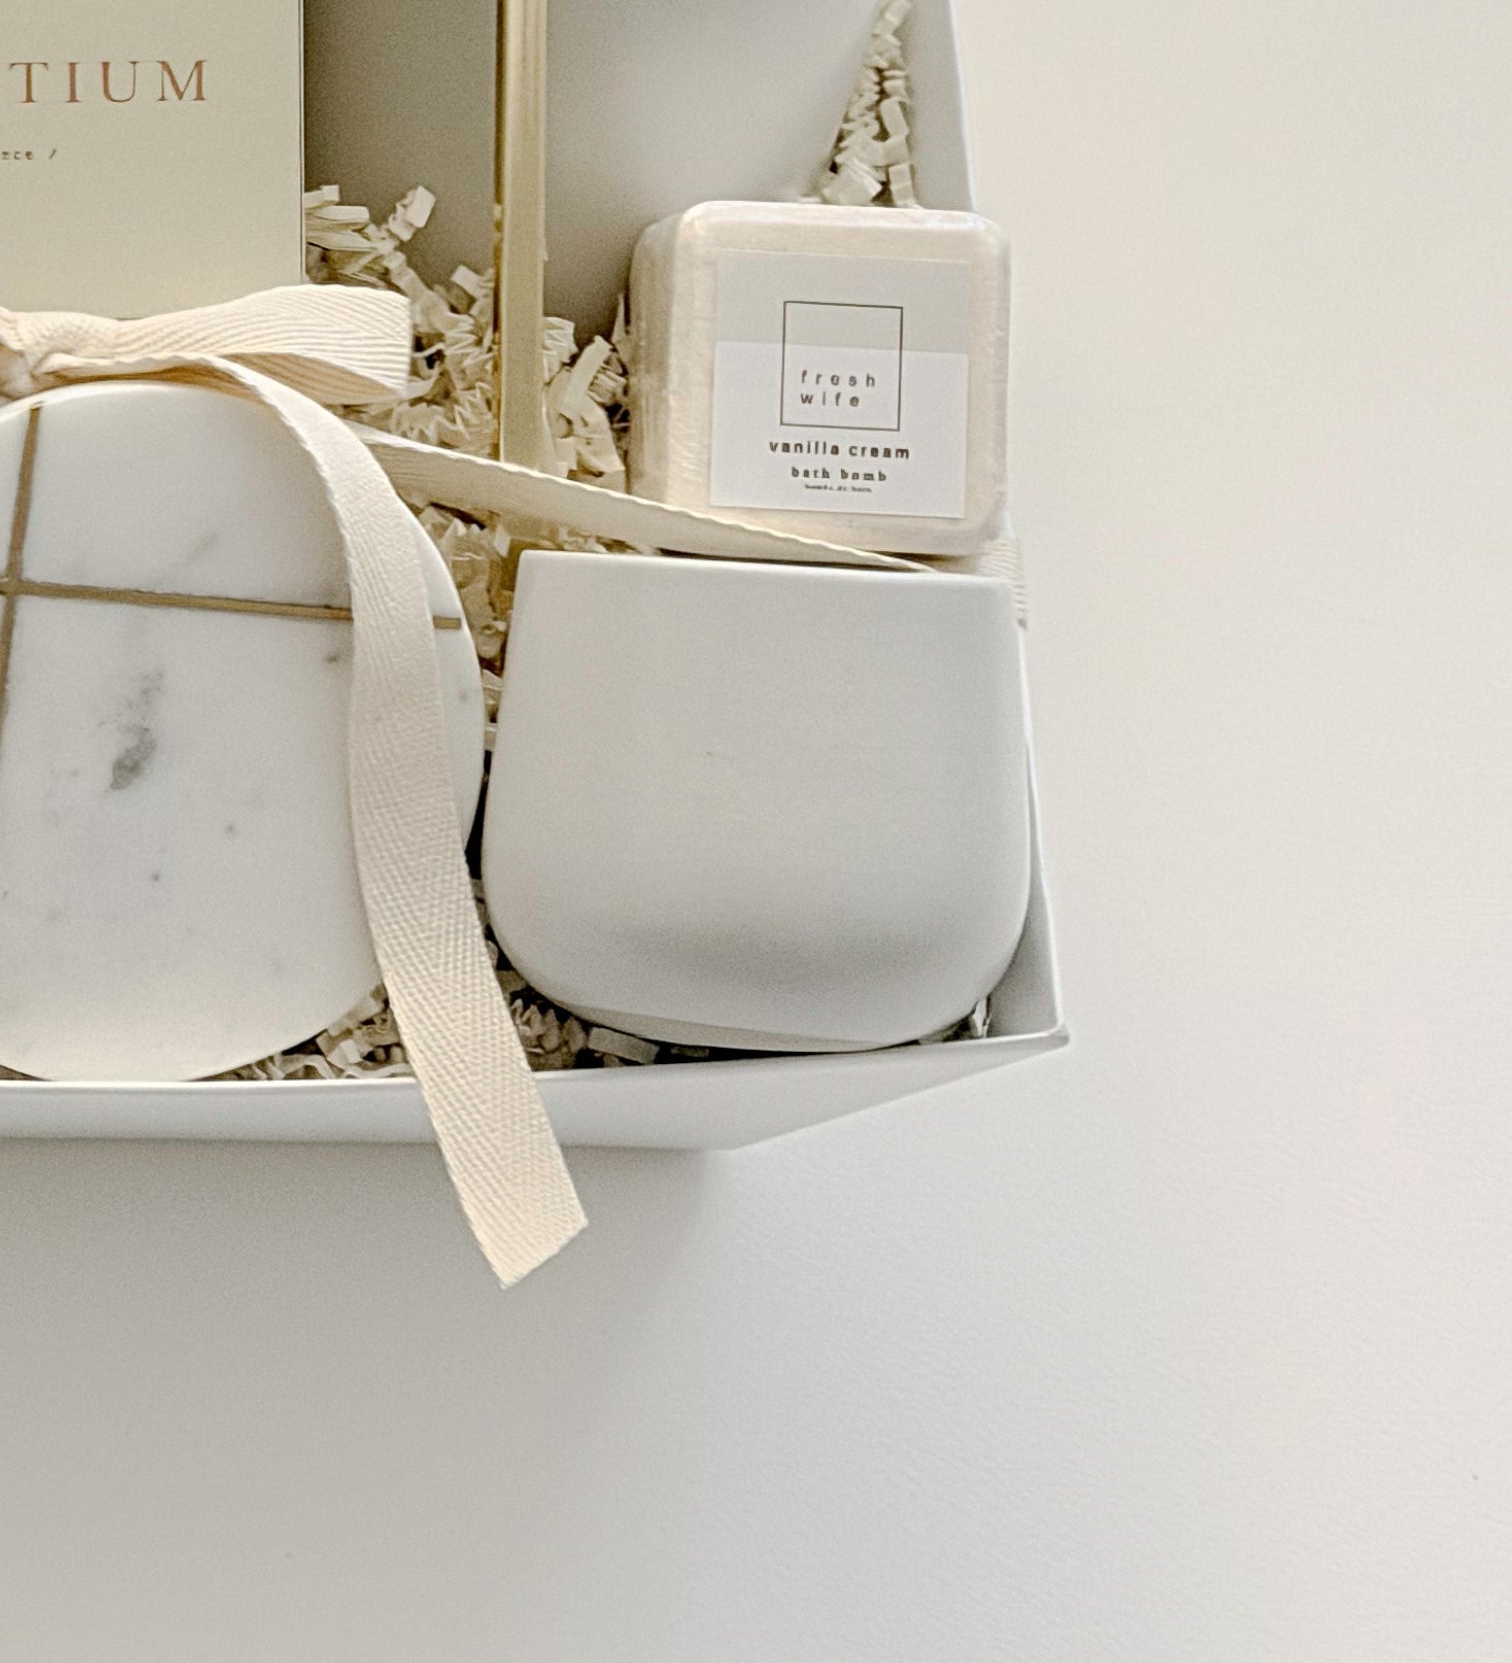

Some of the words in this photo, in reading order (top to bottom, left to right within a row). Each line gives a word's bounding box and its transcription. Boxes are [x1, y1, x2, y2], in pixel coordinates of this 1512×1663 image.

[800, 392, 860, 407] wife
[769, 440, 840, 456] vanilla
[848, 445, 910, 460] cream
[791, 466, 830, 479] bath
[840, 468, 887, 482] bomb
